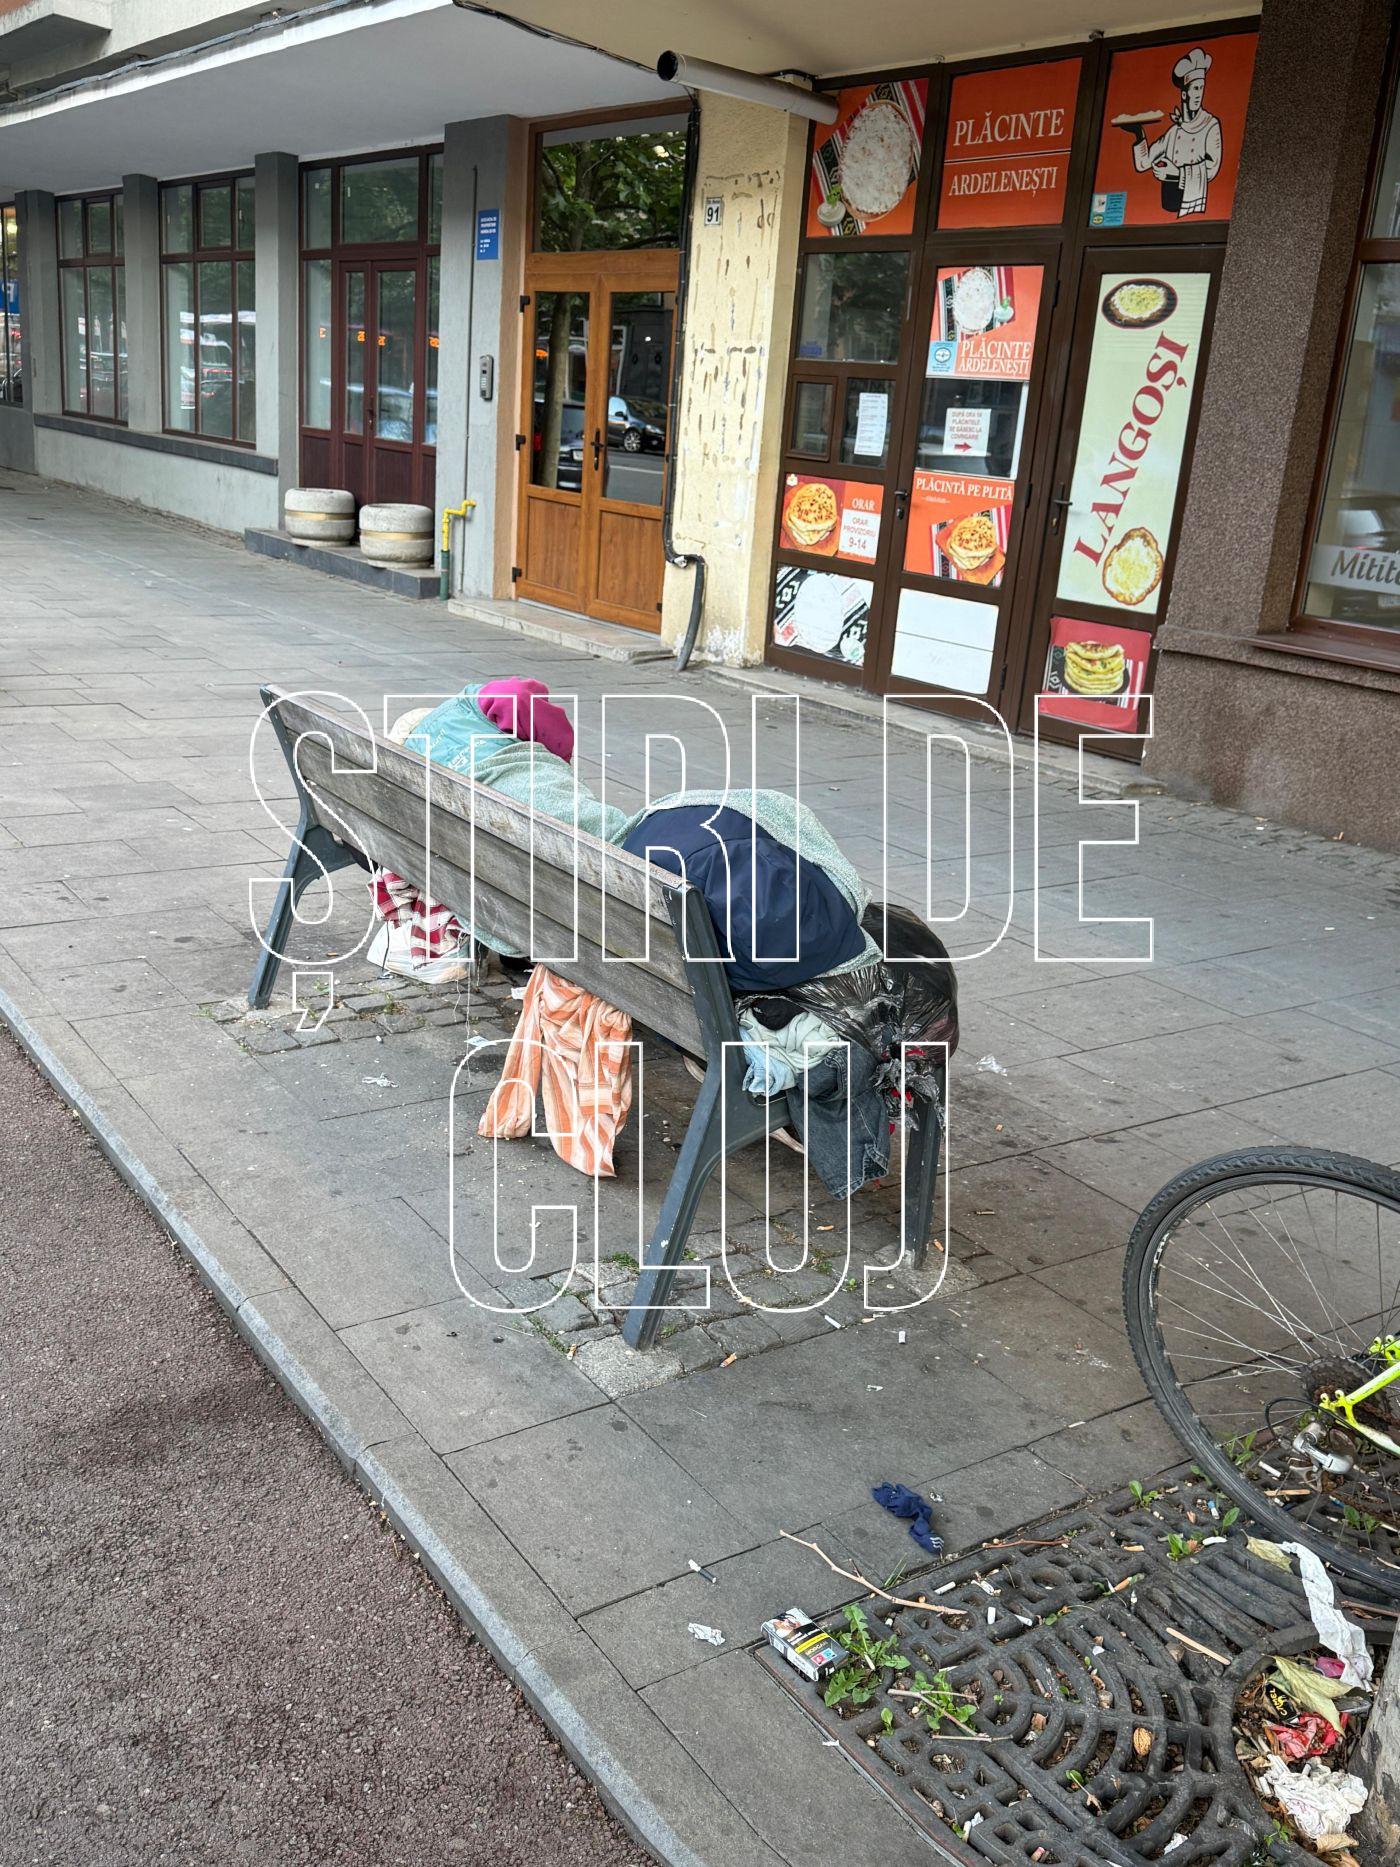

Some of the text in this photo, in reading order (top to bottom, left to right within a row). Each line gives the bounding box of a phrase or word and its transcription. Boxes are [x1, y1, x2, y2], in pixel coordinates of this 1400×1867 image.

[953, 108, 1065, 146] PLĂCINTE
[948, 167, 1058, 198] ARDELENEȘTI
[707, 206, 720, 222] 91
[960, 336, 1032, 359] PLĂCINTE
[958, 358, 1030, 376] ARDELENEȘTI
[1073, 330, 1189, 567] LANGOȘI
[915, 477, 1013, 500] PLĂCINTĂ PE PLITĂ
[852, 498, 876, 511] ORAR
